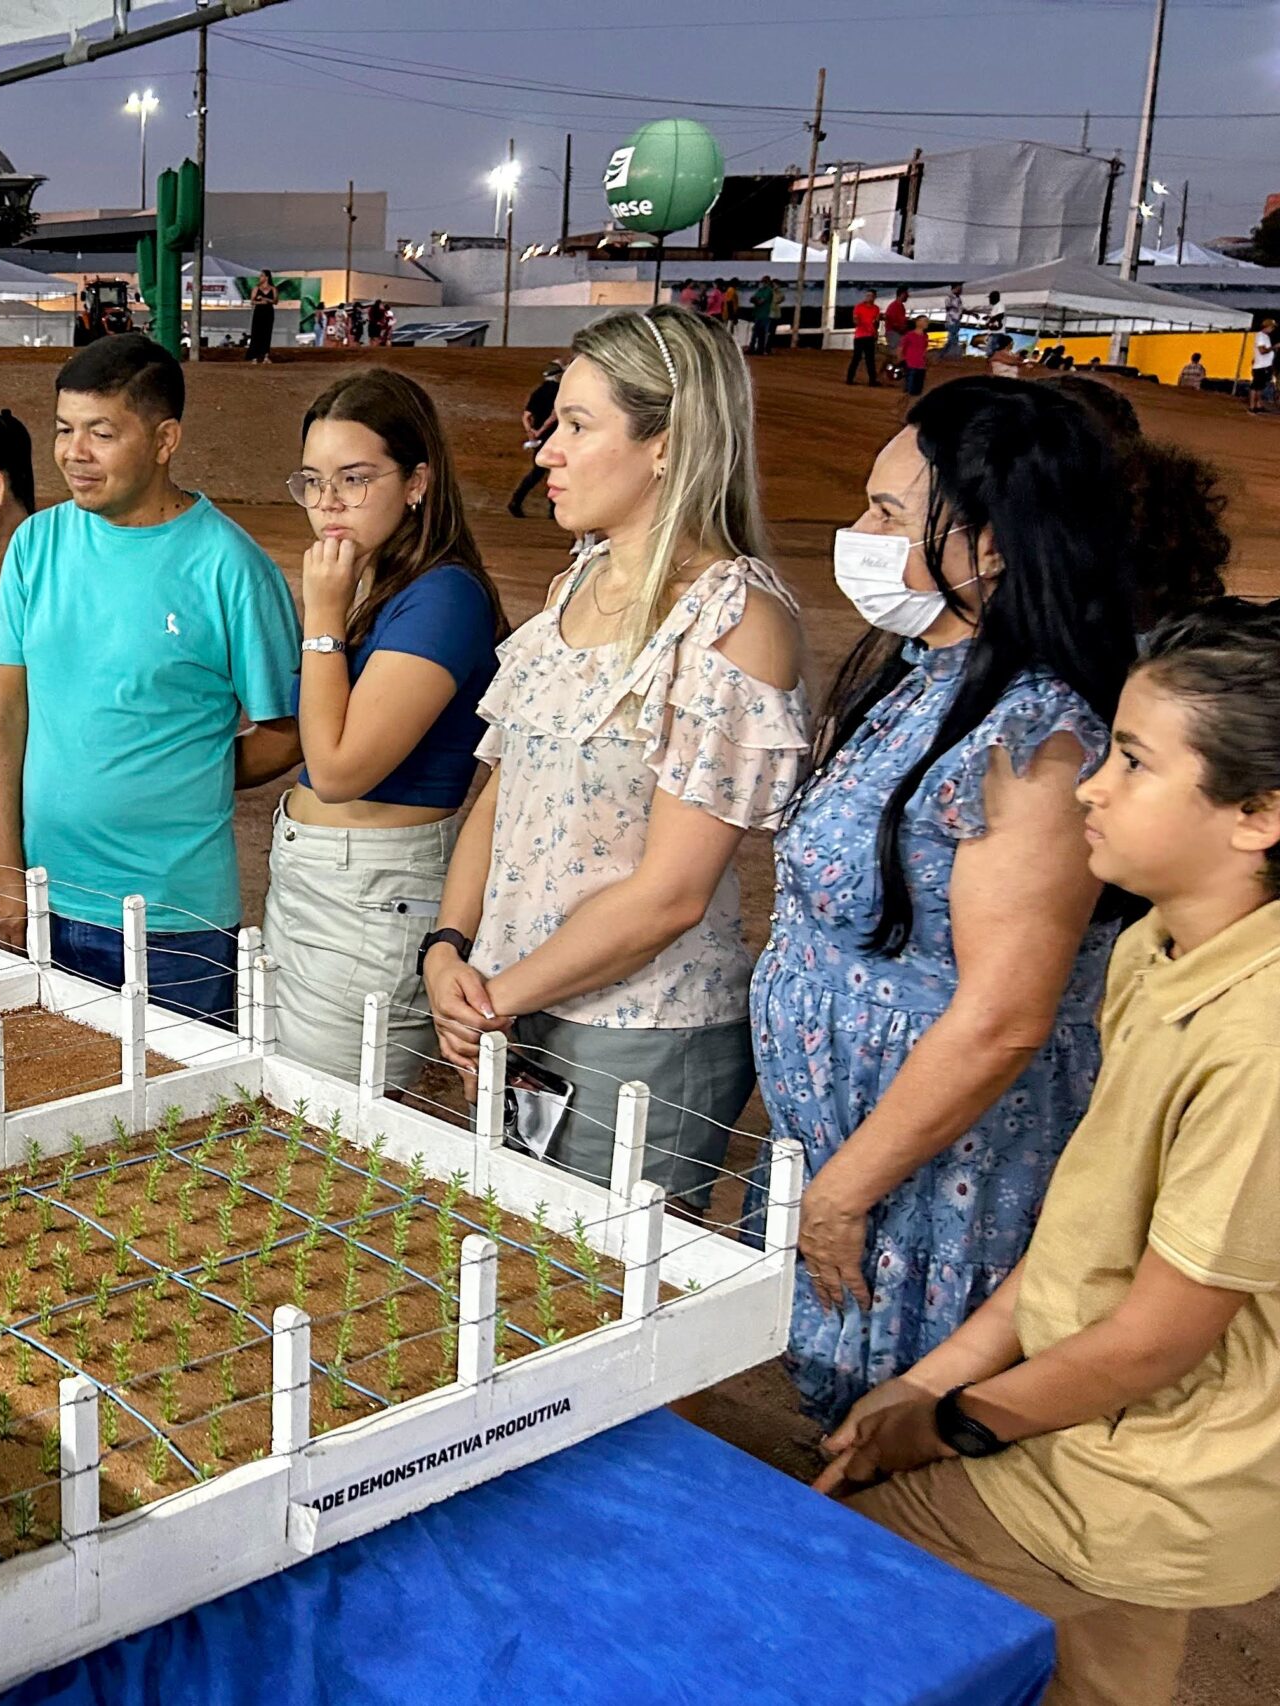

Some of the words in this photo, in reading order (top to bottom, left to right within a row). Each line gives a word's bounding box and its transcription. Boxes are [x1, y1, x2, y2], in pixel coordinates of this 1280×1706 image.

[610, 200, 653, 218] nese
[304, 1488, 345, 1514] ADE
[348, 1434, 482, 1501] DEMONSTRATIVA
[485, 1397, 571, 1445] PRODUTIVA
